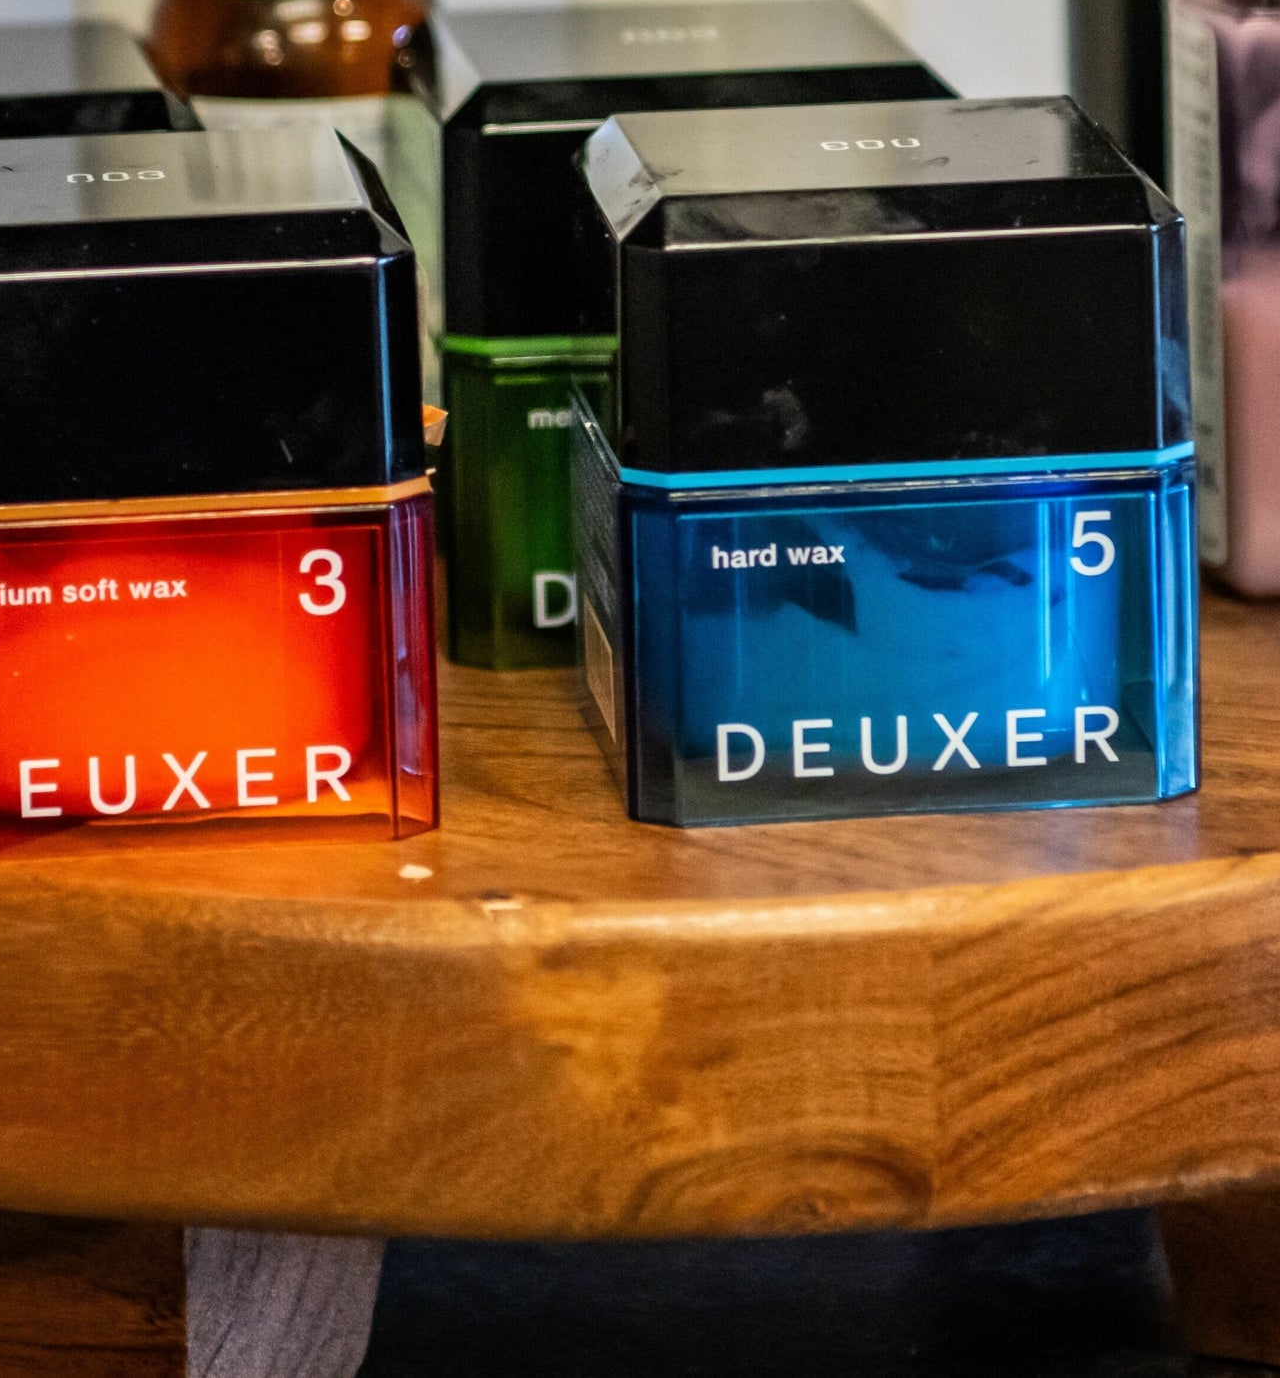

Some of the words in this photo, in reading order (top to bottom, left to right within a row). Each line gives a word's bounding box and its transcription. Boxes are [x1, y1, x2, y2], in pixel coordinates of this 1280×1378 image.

[711, 542, 778, 570] hard
[787, 543, 846, 566] wax
[1069, 510, 1117, 577] 5
[62, 578, 120, 604] soft
[128, 578, 188, 601] wax
[298, 547, 348, 616] 3
[717, 705, 1120, 782] DEUXER
